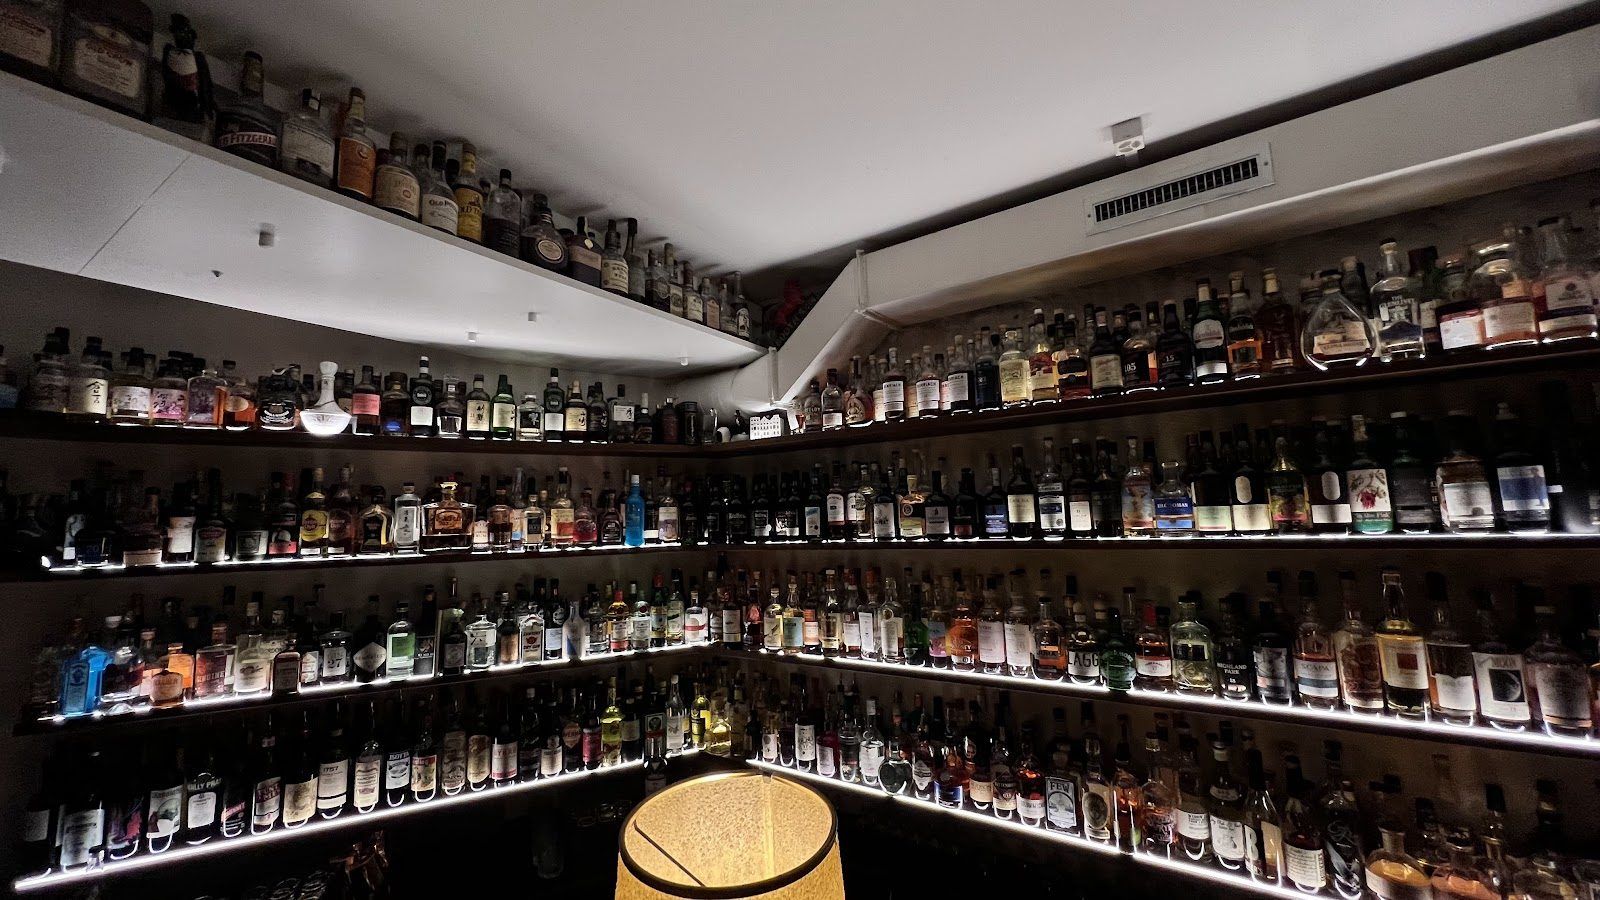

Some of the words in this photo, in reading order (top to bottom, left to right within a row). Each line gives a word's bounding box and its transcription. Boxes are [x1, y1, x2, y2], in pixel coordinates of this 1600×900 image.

[1068, 652, 1099, 668] LAGG
[1216, 662, 1247, 670] HIGHLAND
[1050, 781, 1071, 794] FEW
